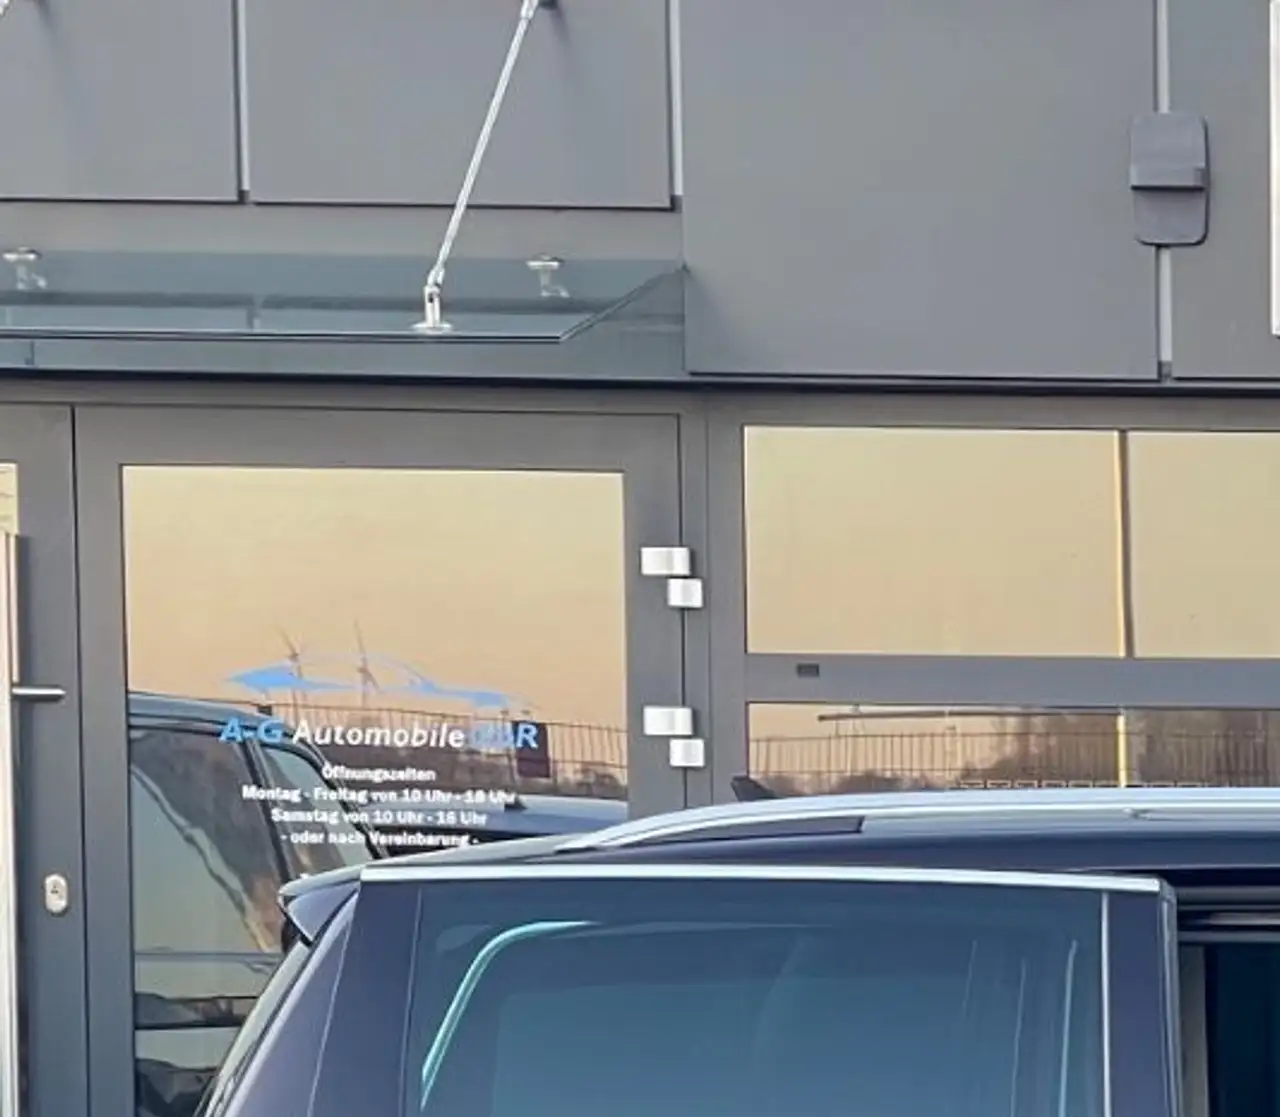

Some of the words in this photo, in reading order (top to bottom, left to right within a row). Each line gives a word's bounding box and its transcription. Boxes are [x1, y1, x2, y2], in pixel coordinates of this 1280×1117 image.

[219, 717, 284, 743] A-G
[292, 719, 465, 748] Automobile
[242, 785, 301, 803] Montag
[371, 791, 397, 802] von
[402, 788, 421, 802] 10
[425, 789, 452, 803] Uhr
[489, 790, 516, 804] Uhr
[271, 807, 339, 825] Samstag
[343, 811, 369, 823] von
[373, 810, 392, 823] 10
[396, 811, 424, 824] Uhr
[460, 811, 487, 826] Uhr
[290, 830, 325, 844] oder
[328, 831, 365, 844] nach
[368, 831, 470, 848] Vereinbarung
